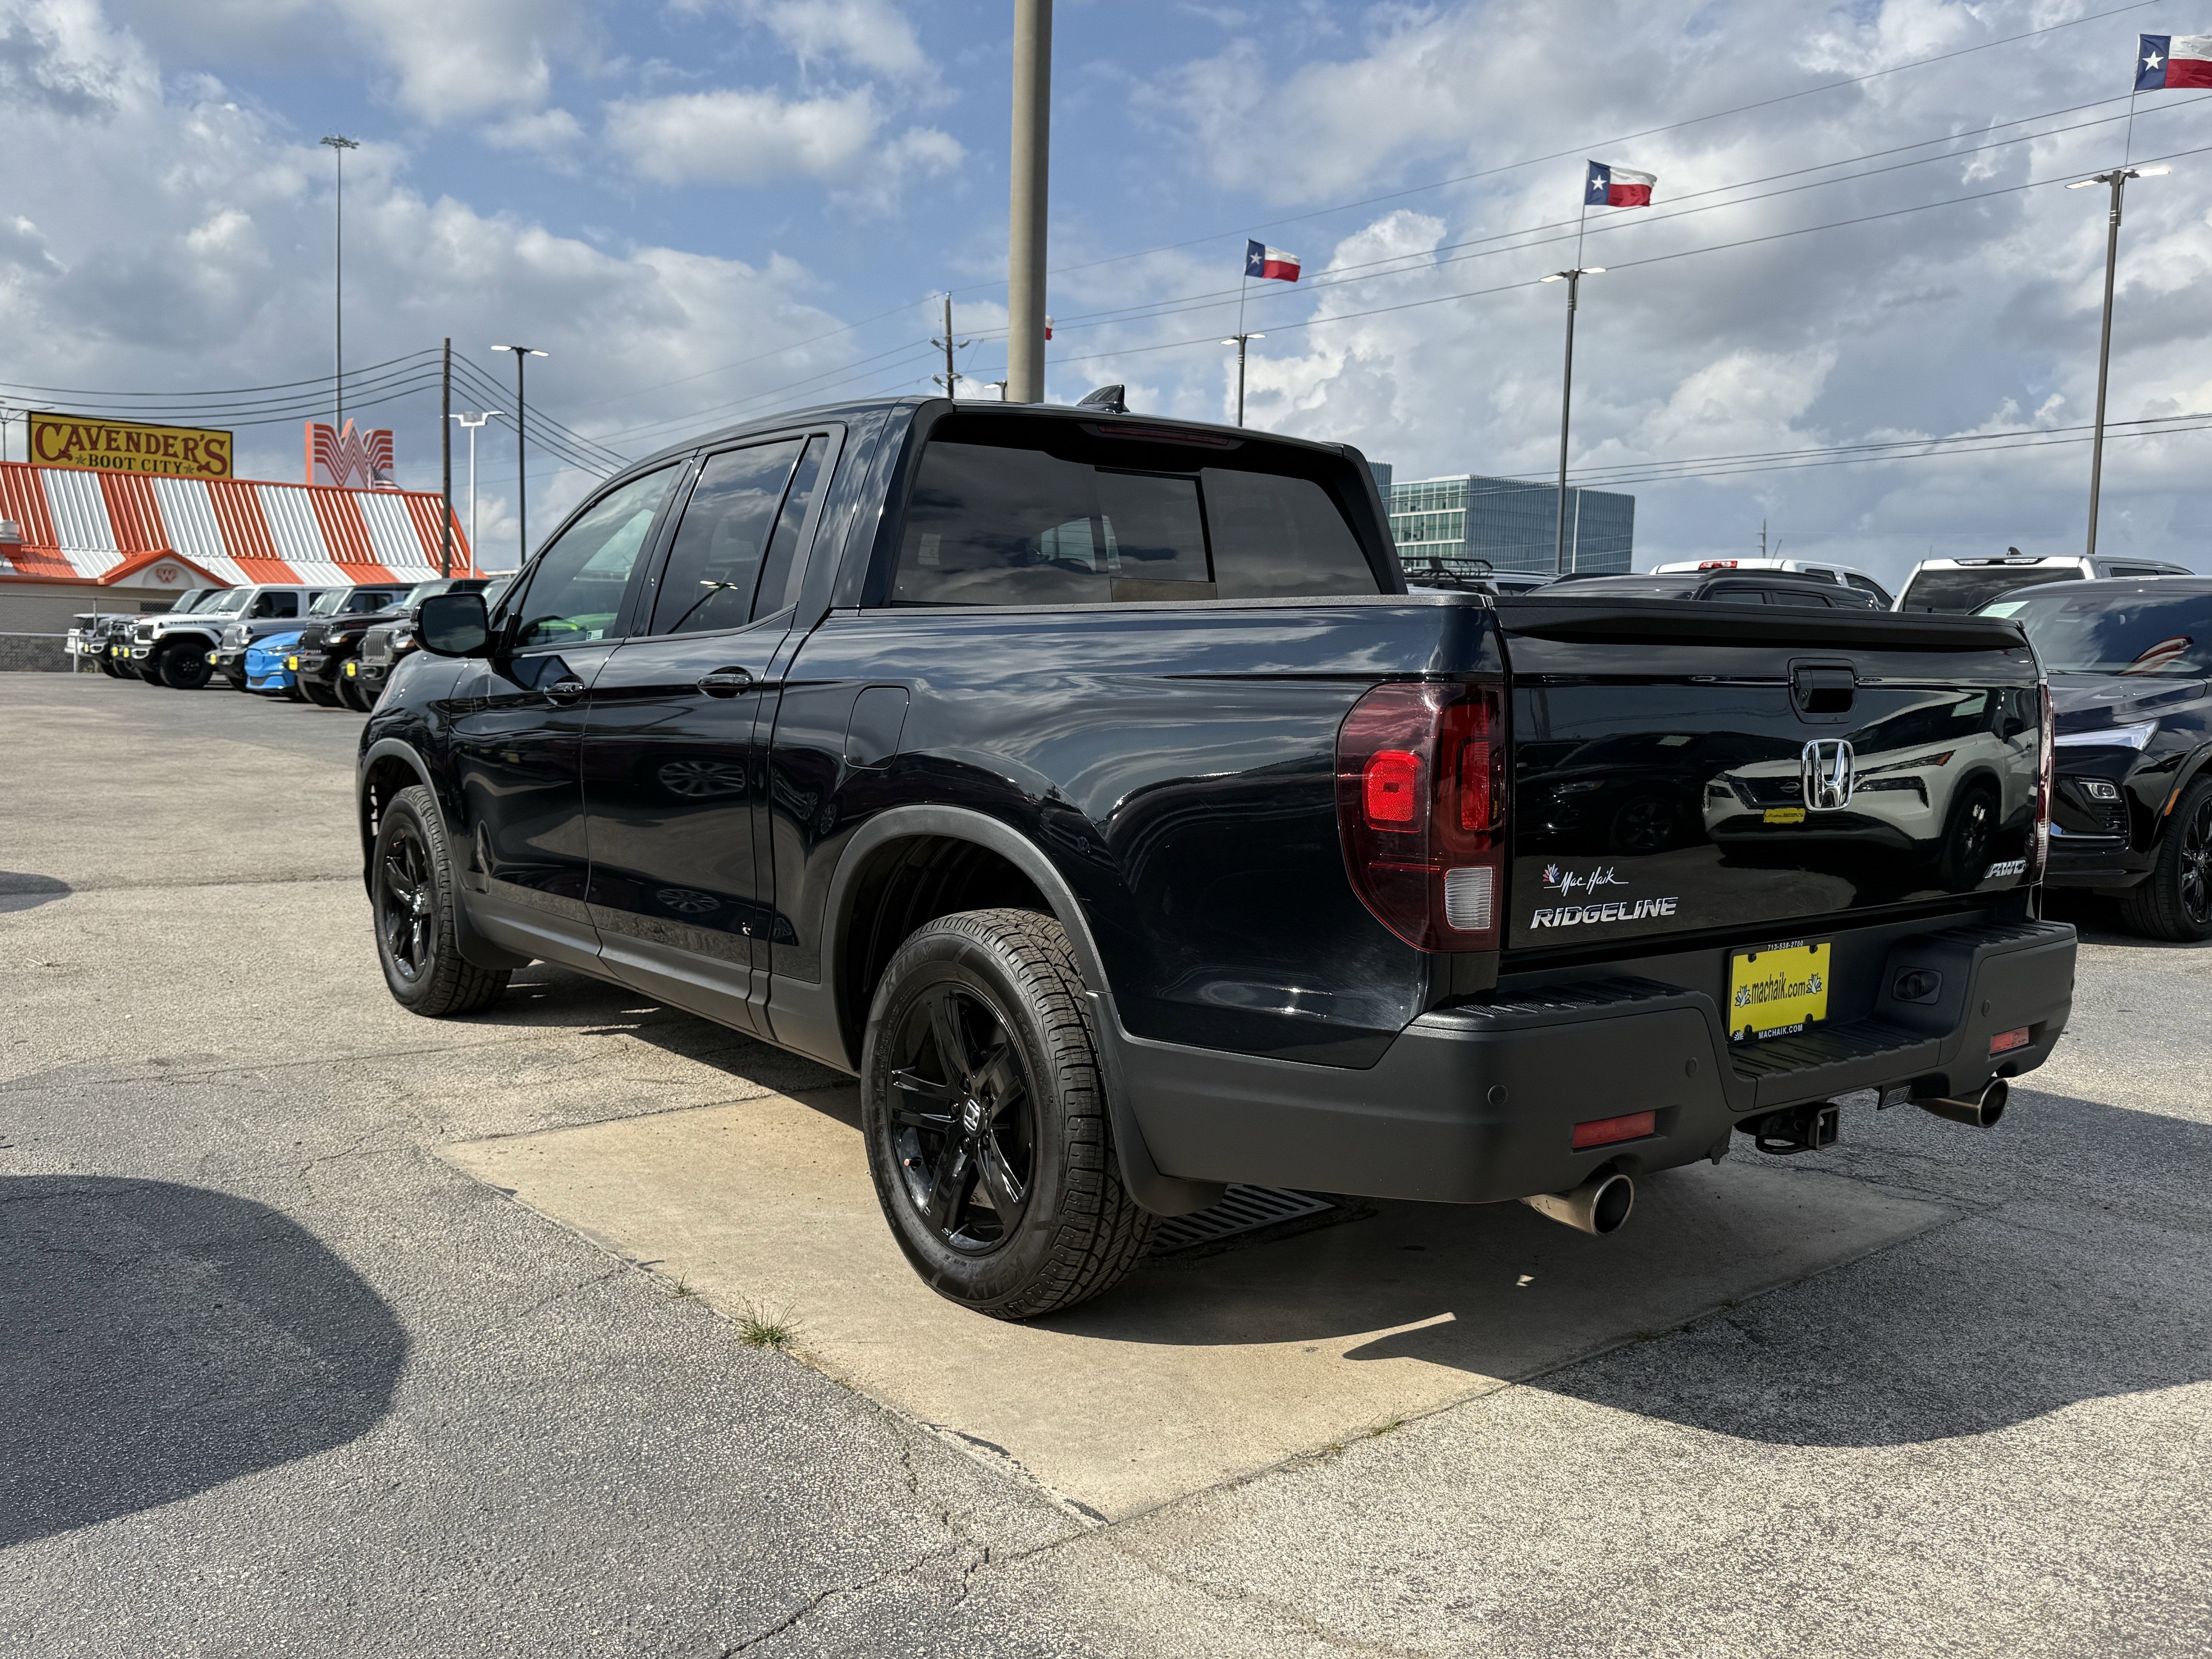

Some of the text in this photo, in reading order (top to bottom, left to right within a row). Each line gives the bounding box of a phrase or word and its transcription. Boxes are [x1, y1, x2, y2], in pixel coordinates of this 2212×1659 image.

[35, 422, 228, 476] CAVENDER'S
[89, 453, 182, 474] BOOT CITY
[1543, 866, 1629, 897] Mac Haik
[1984, 860, 2026, 878] AWD
[1530, 897, 1678, 929] RIDGELINE
[1751, 971, 1805, 1005] machaik.com
[1758, 1024, 1803, 1039] MACHAIK.COM
